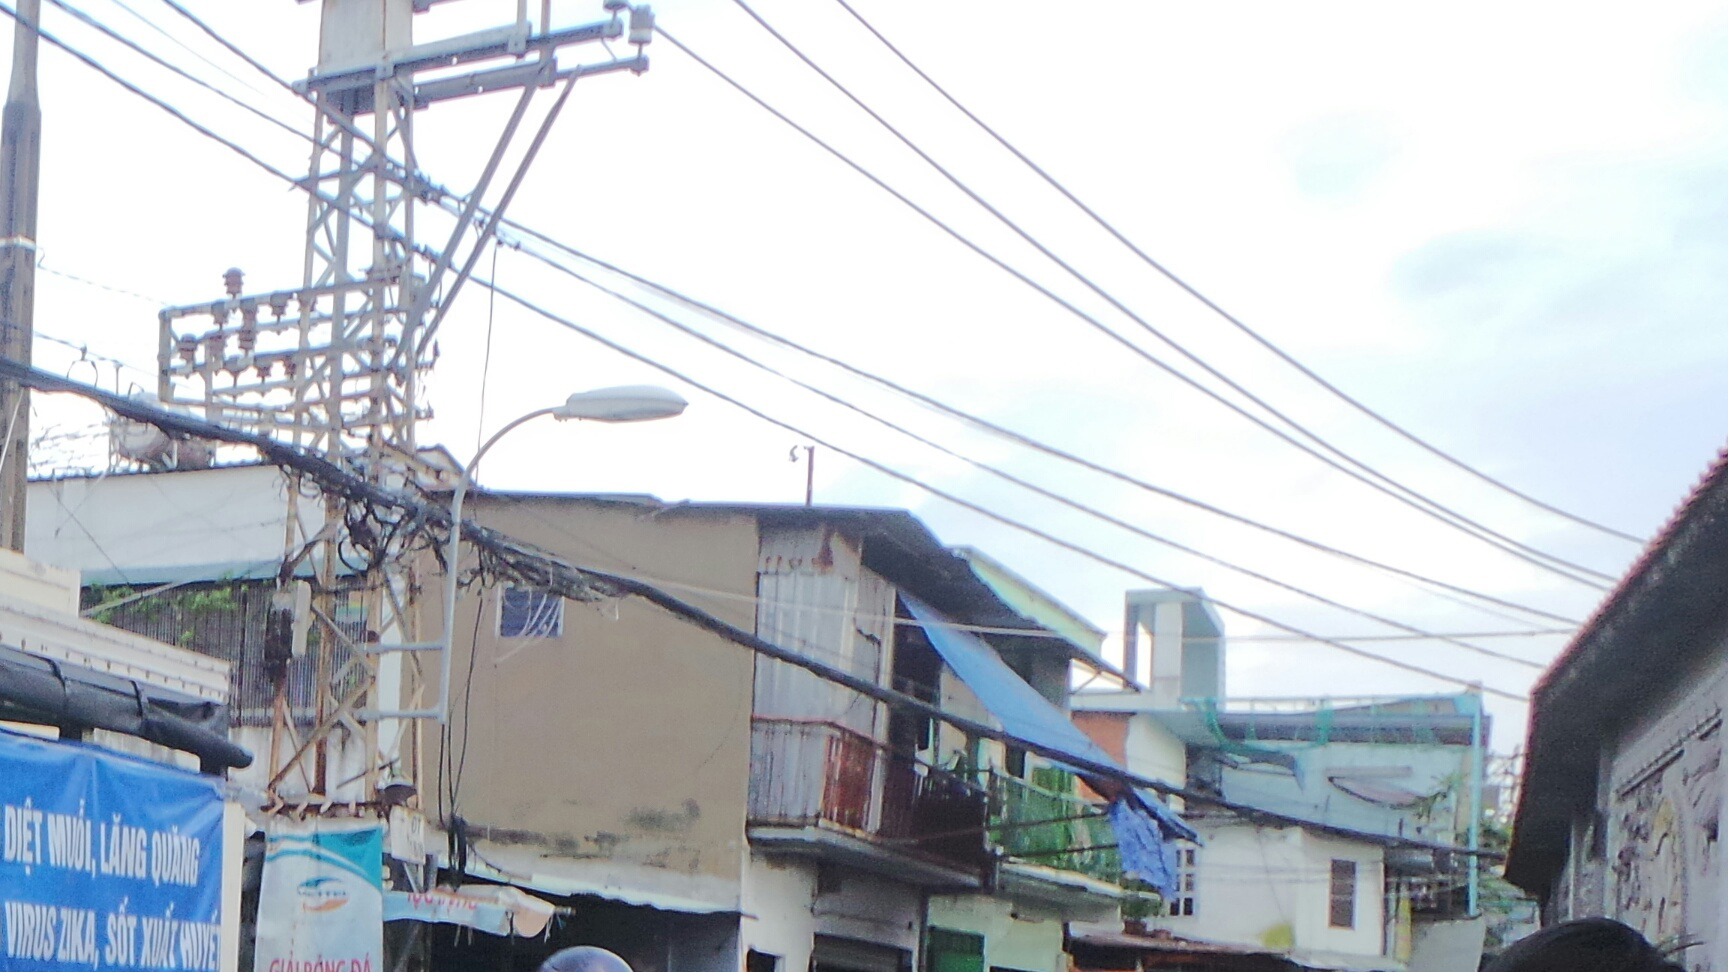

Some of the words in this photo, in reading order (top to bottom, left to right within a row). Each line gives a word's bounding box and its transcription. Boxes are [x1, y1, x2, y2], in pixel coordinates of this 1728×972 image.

[4, 796, 43, 876] DIỆT
[100, 813, 148, 879] LĂNG
[151, 825, 201, 888] QUĂNG
[5, 900, 57, 961] VIRUS
[57, 907, 100, 970] ZIKA,
[105, 896, 138, 967] SỐT
[140, 902, 178, 968] XUẤT
